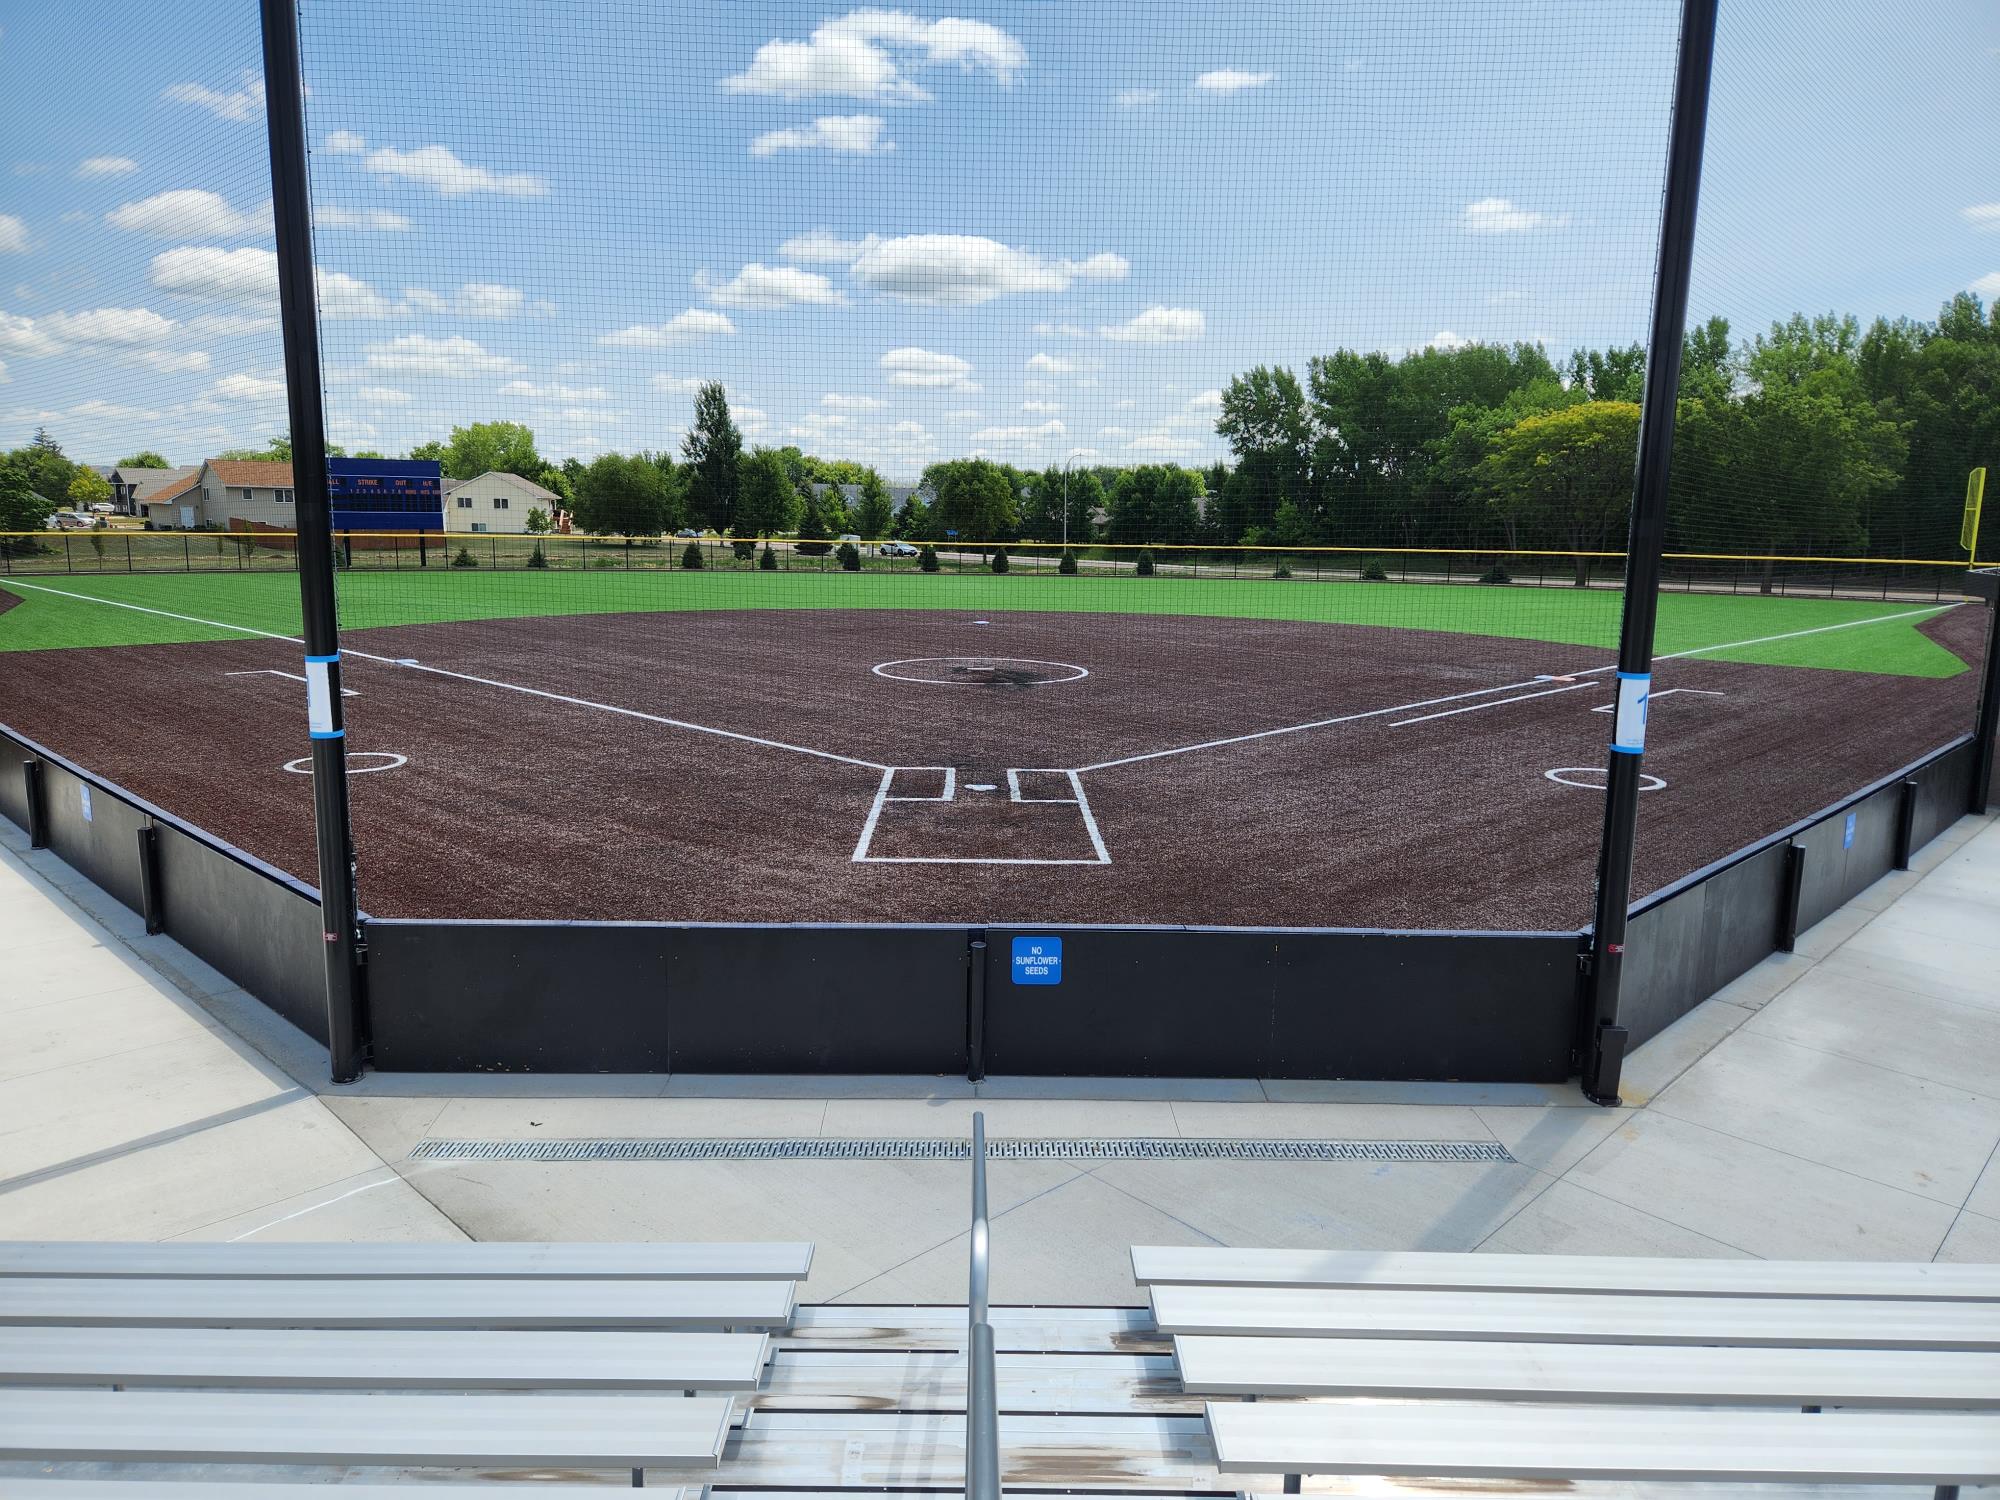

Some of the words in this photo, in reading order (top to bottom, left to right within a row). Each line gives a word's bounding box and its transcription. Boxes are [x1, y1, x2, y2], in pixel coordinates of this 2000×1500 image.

[1032, 946, 1042, 954] NO
[1016, 956, 1058, 964] SUNFLOWER
[1024, 966, 1048, 974] SEEDS
